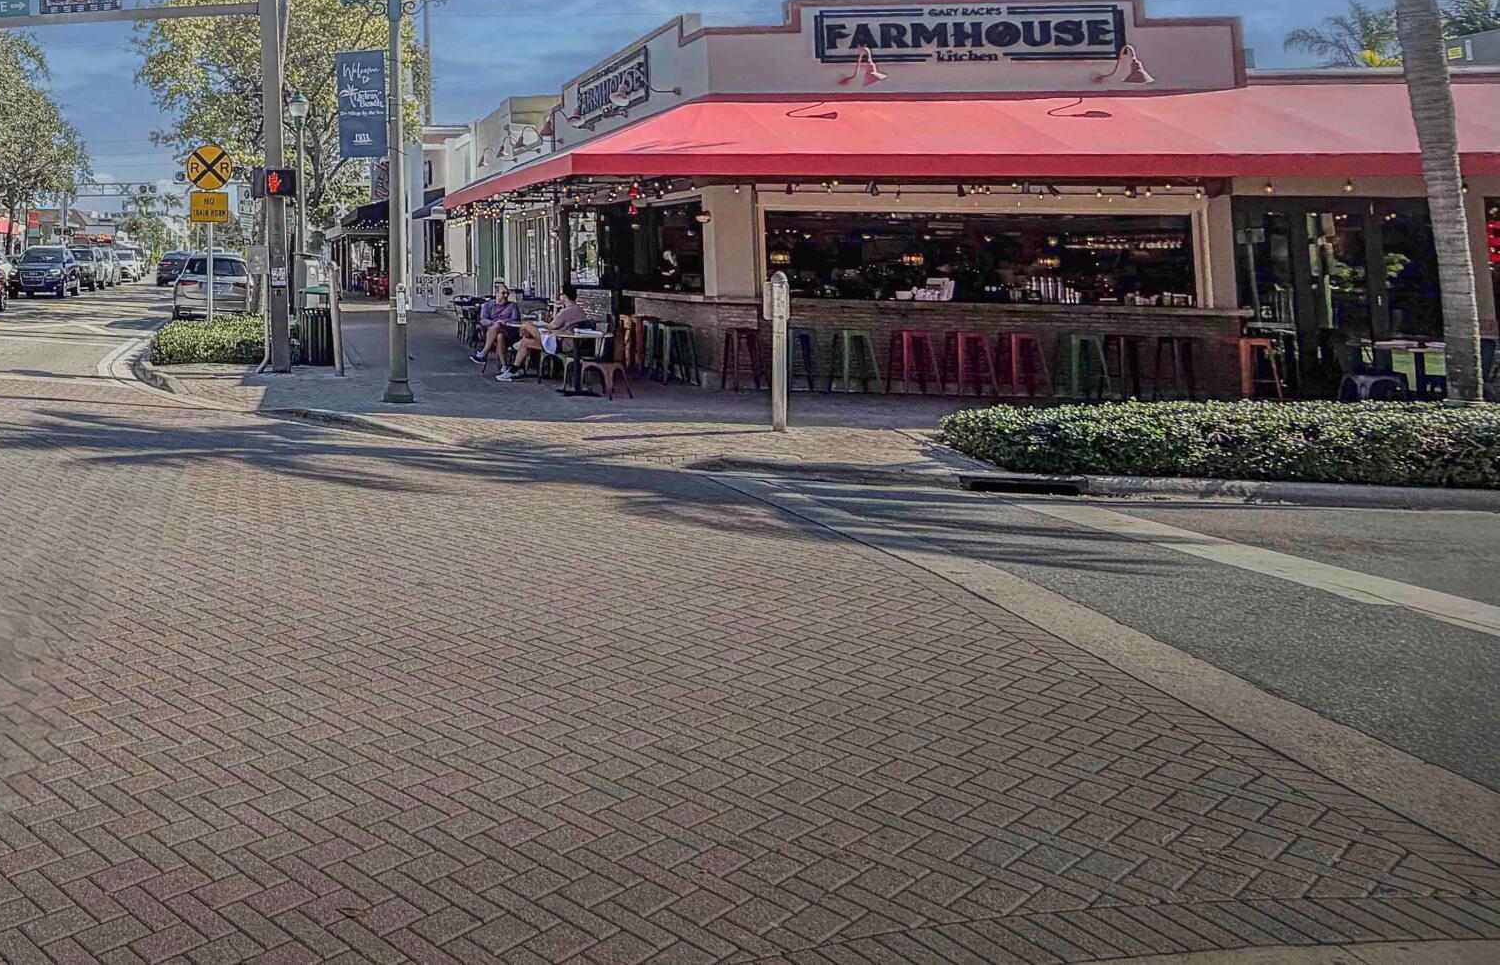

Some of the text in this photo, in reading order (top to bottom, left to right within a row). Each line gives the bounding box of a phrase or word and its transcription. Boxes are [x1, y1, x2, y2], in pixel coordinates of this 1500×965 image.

[928, 8, 959, 17] GARY
[825, 19, 1114, 49] FARMHOUSE
[936, 50, 998, 62] kitchen
[342, 62, 380, 82] Welcome
[190, 162, 229, 173] R R
[203, 197, 215, 205] NO
